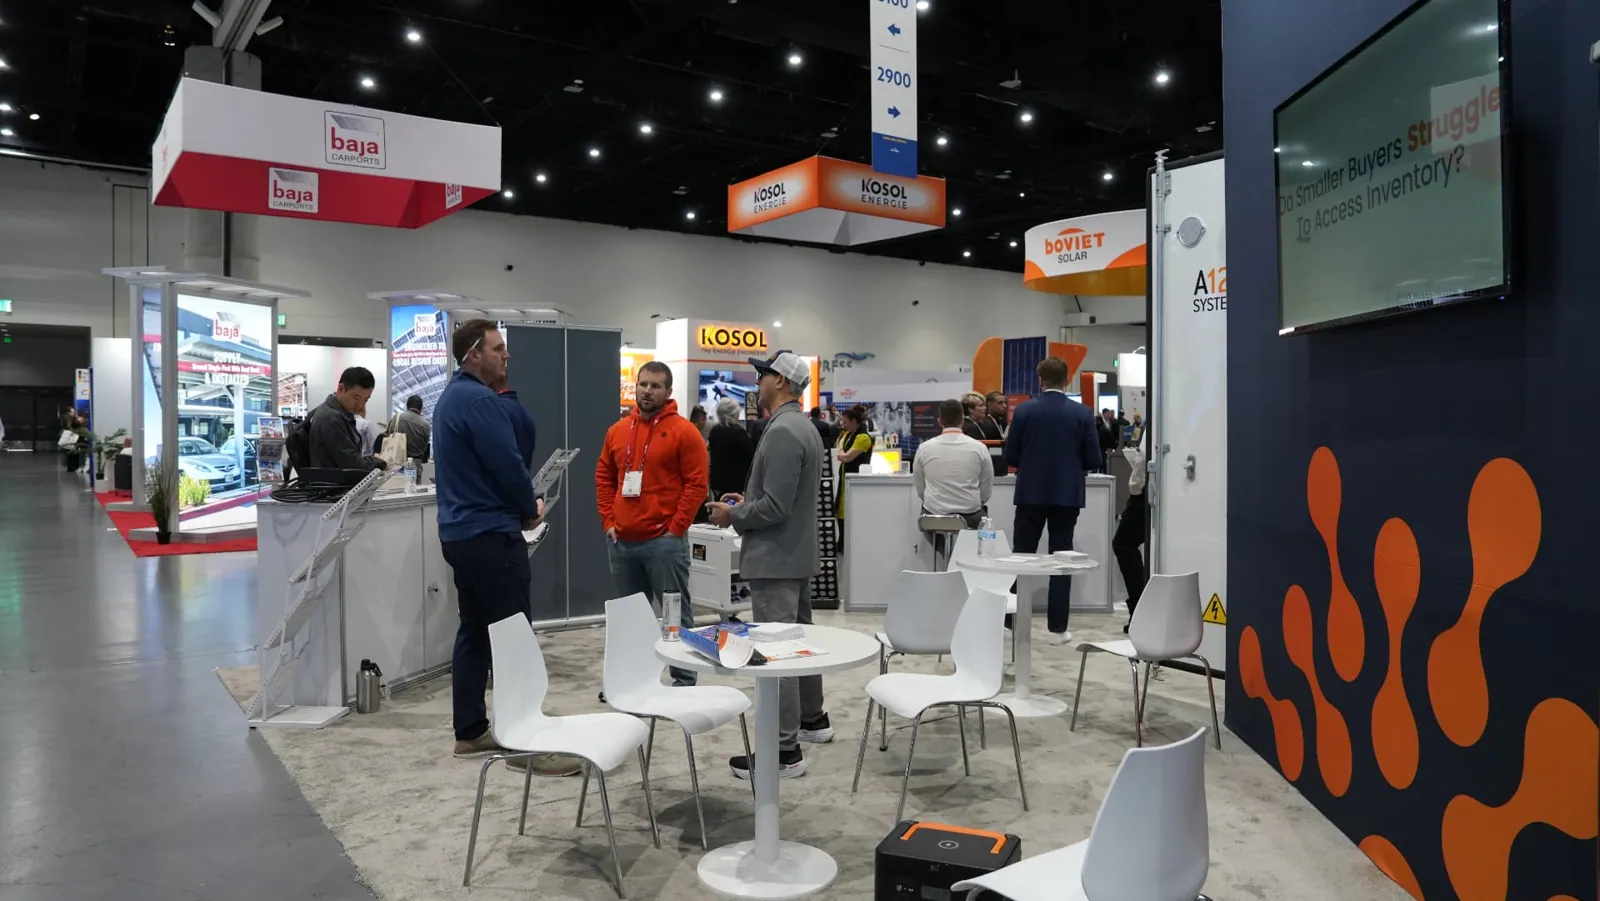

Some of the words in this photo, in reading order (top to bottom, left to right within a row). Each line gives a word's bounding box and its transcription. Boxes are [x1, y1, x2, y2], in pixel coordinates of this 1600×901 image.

[877, 66, 911, 88] 2900
[331, 126, 379, 157] baja
[1279, 195, 1294, 216] Do
[1296, 167, 1344, 207] Smaller
[1348, 138, 1402, 182] Buyers
[1408, 85, 1500, 152] Struggle
[331, 153, 380, 165] CARPORTS
[273, 179, 313, 203] baja
[754, 182, 786, 204] KOSOL
[861, 177, 907, 199] KOSOL
[1297, 216, 1311, 239] To
[1314, 194, 1363, 231] Access
[1367, 143, 1465, 209] Inventory?
[273, 200, 314, 211] CARPORTS
[754, 196, 787, 213] ENERGIE
[861, 194, 907, 210] ENERGIE
[1057, 250, 1088, 264] SOLAR
[215, 319, 240, 339] baja
[415, 320, 435, 336] baja
[701, 326, 768, 348] KOSOL
[213, 351, 241, 364] SUPPLY
